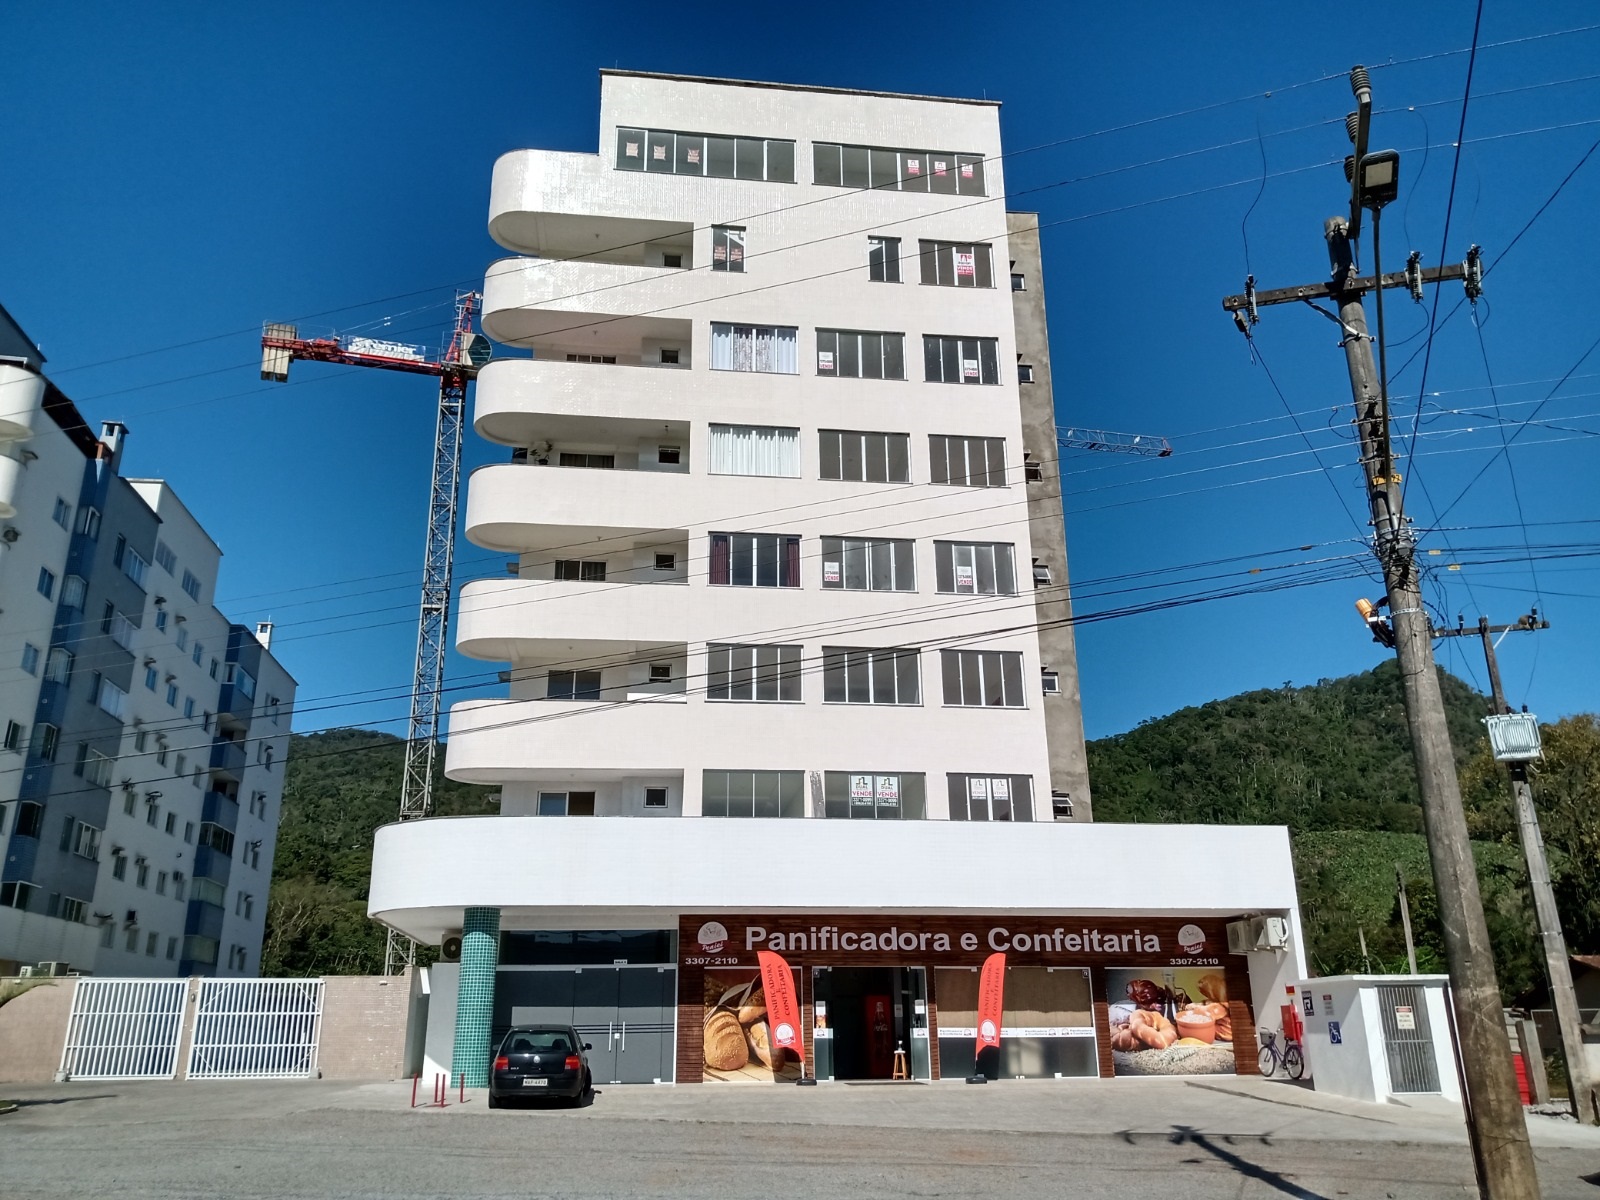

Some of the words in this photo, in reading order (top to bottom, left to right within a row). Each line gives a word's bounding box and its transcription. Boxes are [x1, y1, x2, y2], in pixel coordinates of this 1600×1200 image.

[746, 926, 951, 952] Panificadora
[960, 932, 978, 951] e
[988, 927, 1161, 953] Confeitaria
[685, 957, 738, 965] 3307-2110
[766, 963, 780, 1020] PANIFICADORA
[777, 964, 790, 1016] CONFEITARIA
